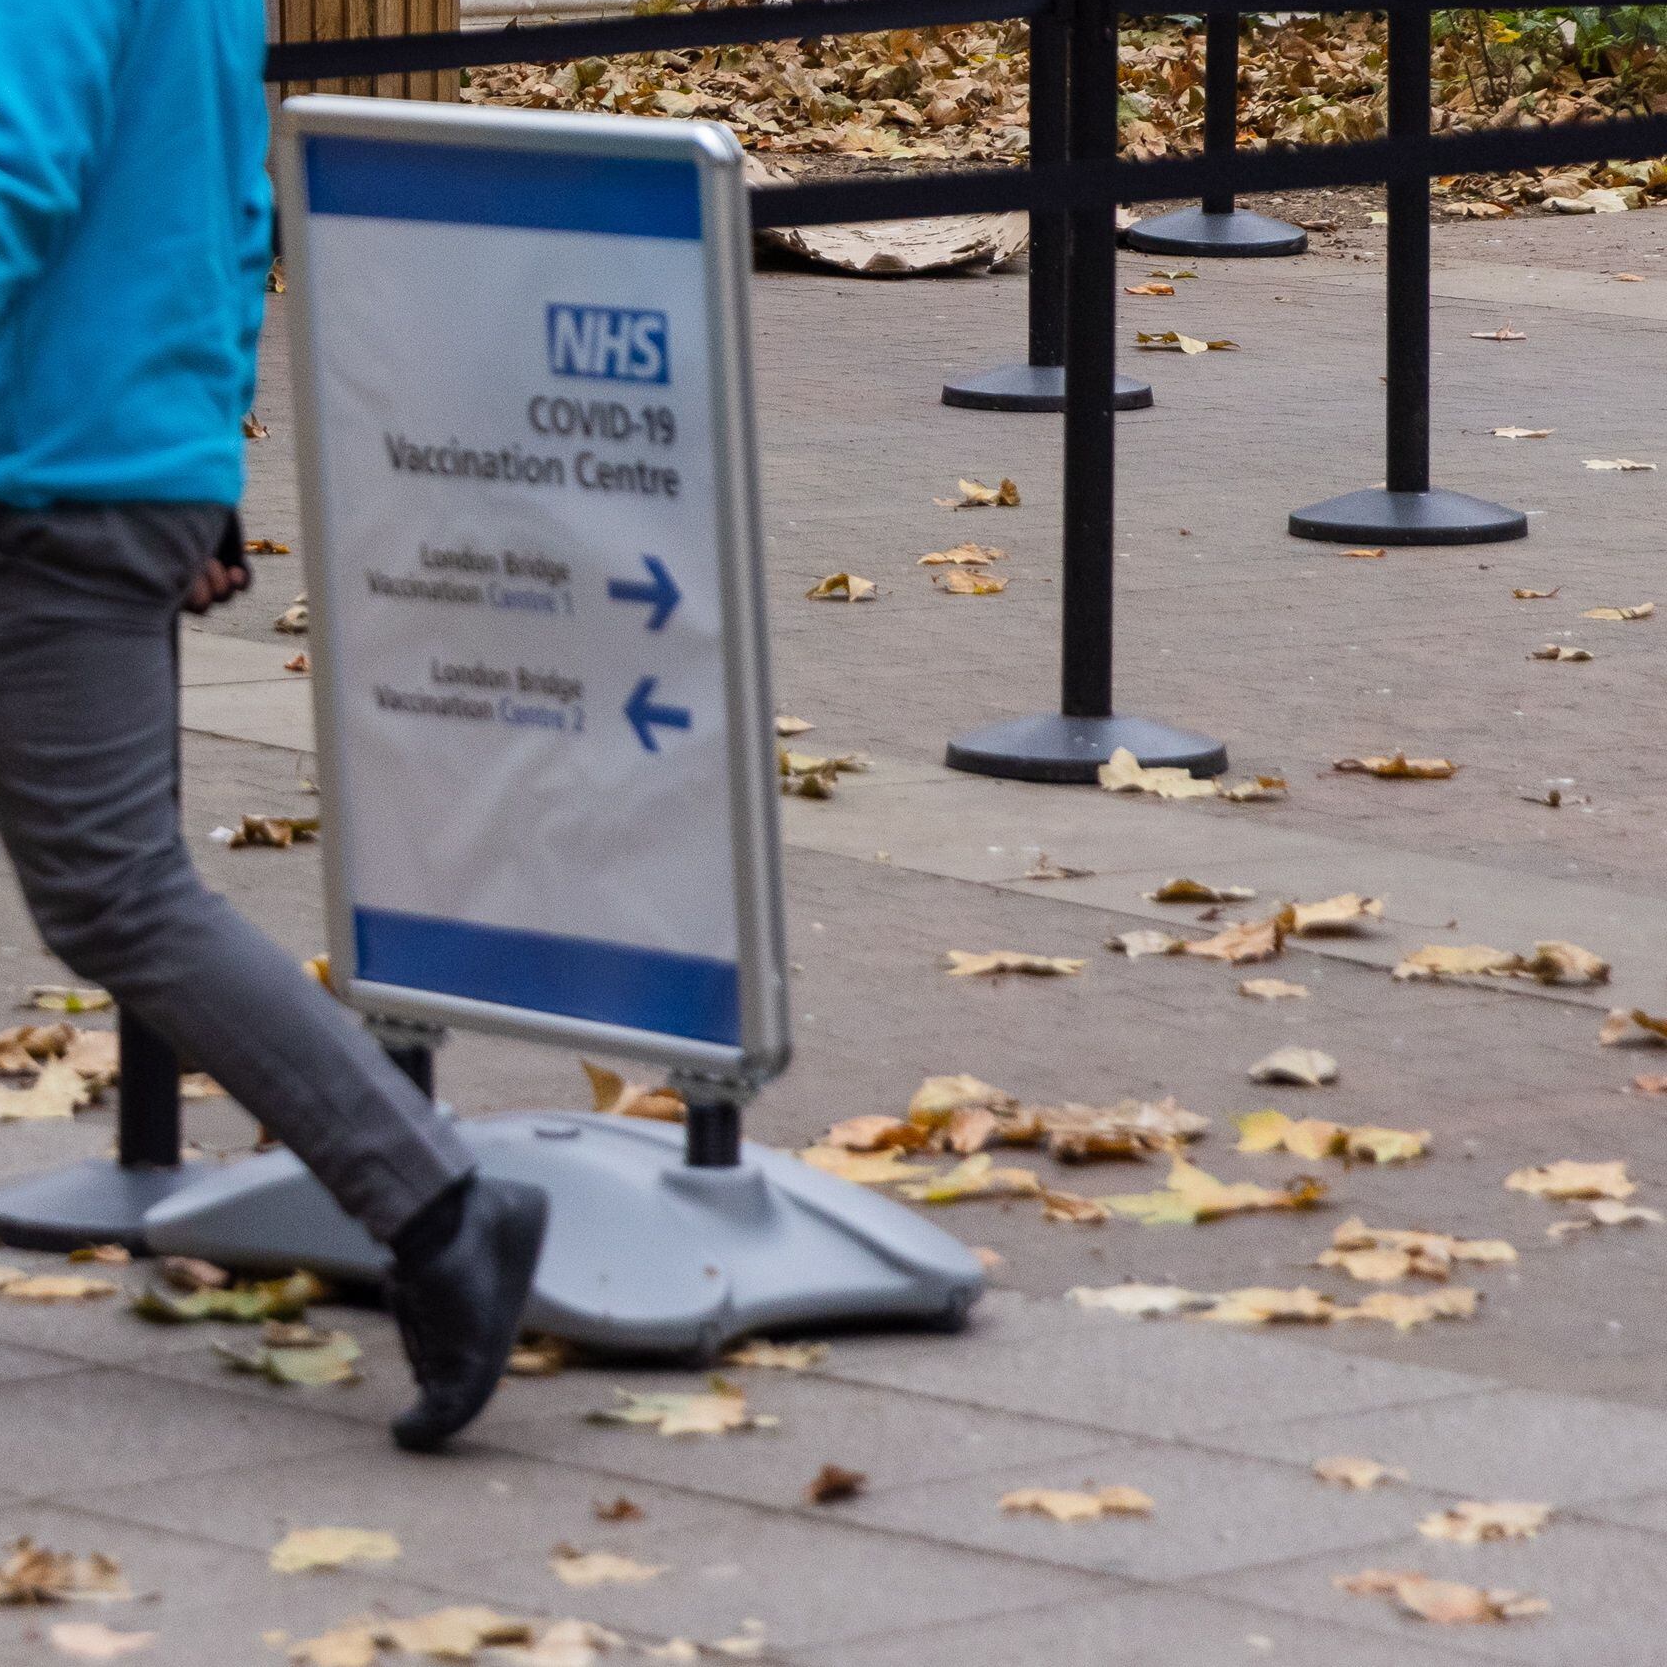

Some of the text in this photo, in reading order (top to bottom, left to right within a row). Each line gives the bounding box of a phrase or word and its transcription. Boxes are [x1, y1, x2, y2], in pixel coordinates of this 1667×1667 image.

[551, 307, 666, 380] NHS
[528, 394, 675, 446] COVID-19
[384, 432, 681, 498] Vaccination Centre
[421, 542, 498, 575] London
[431, 656, 510, 688] London
